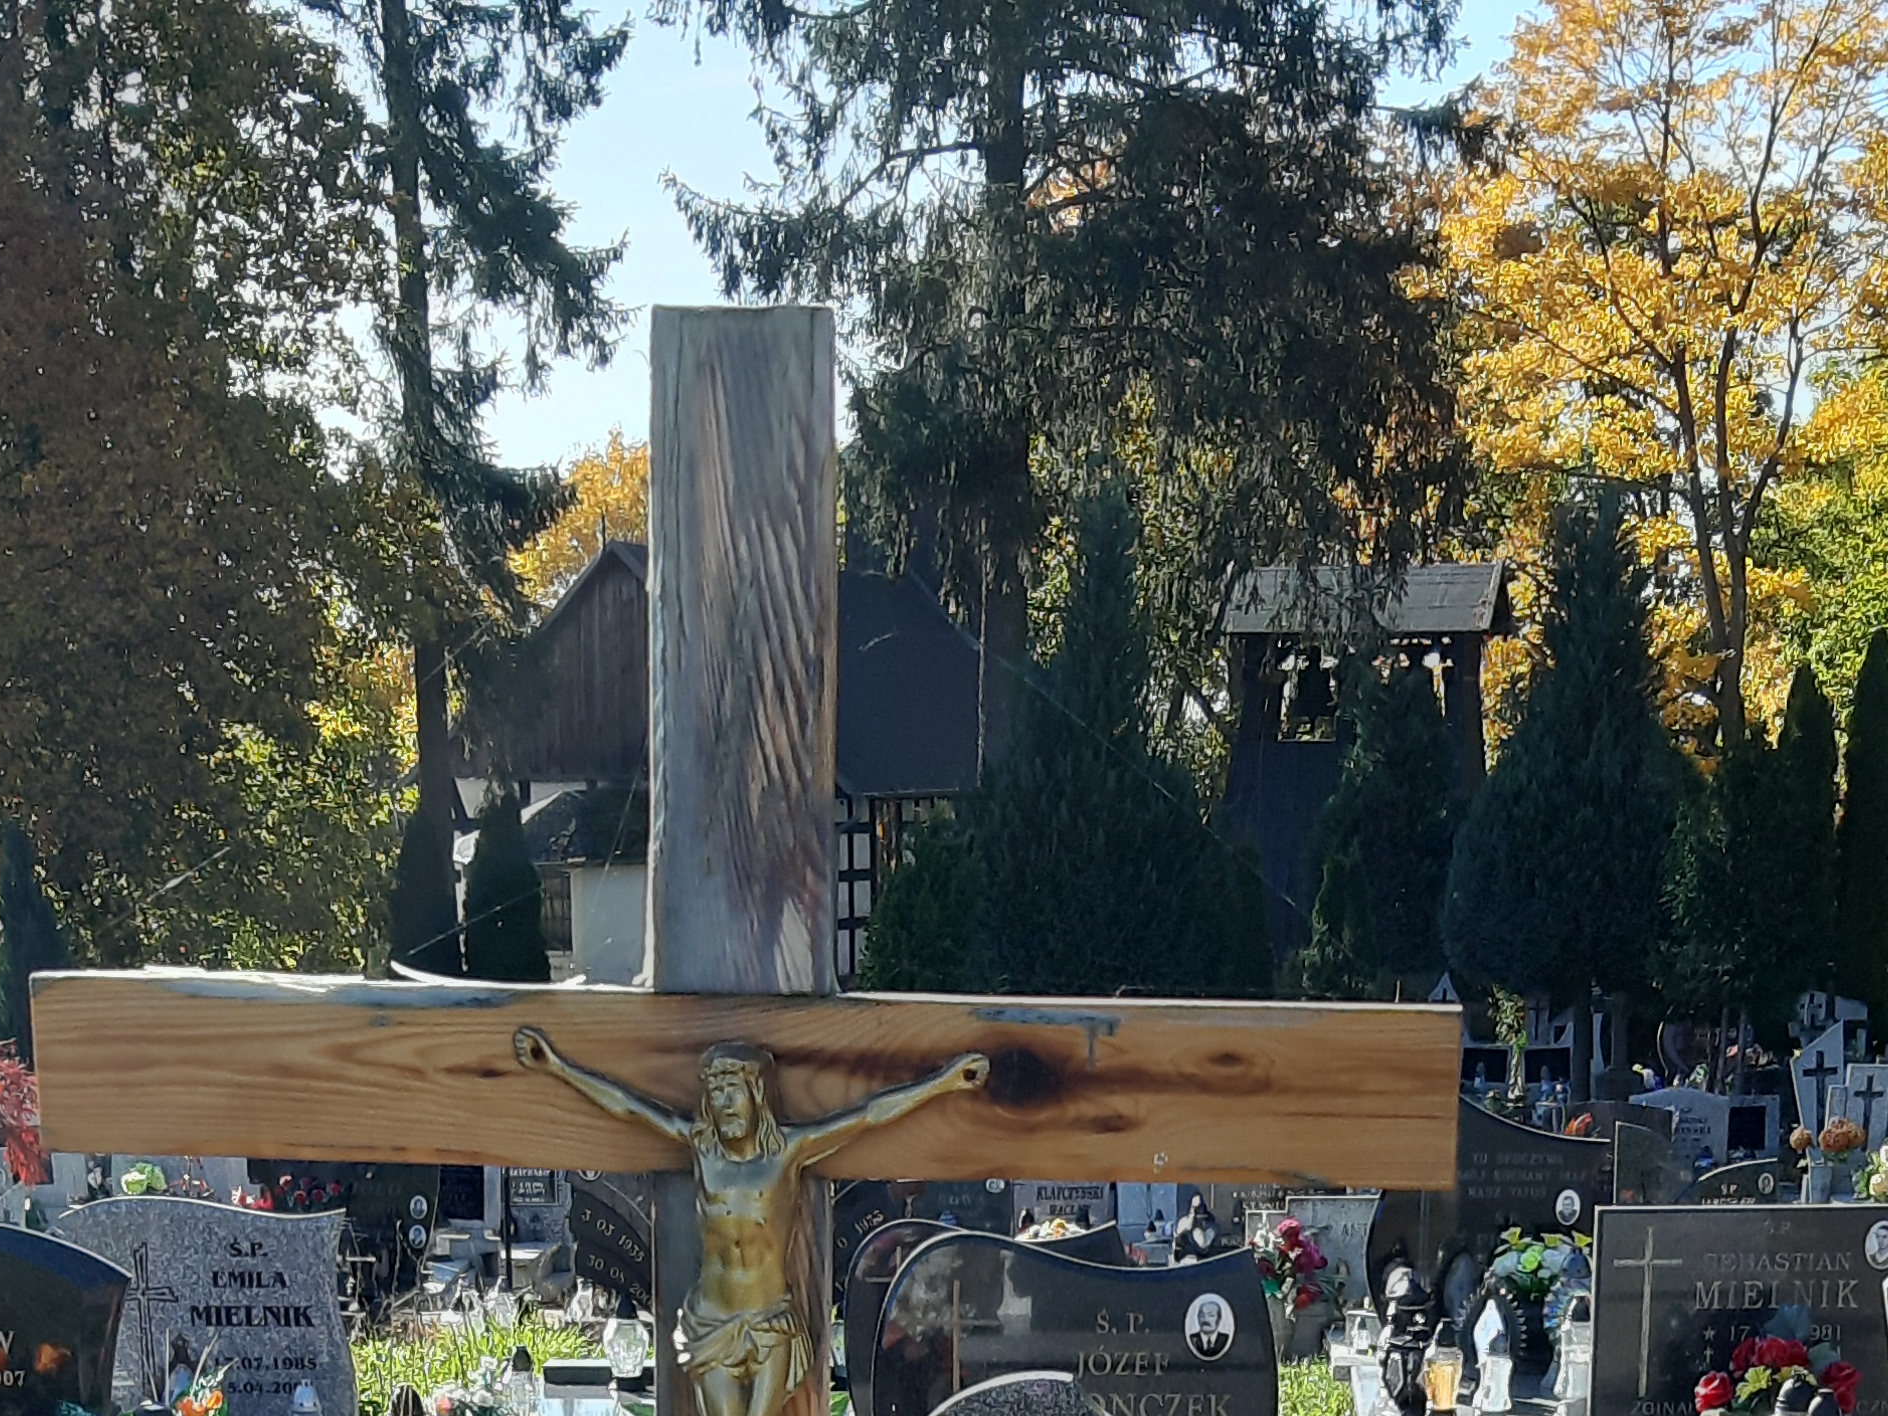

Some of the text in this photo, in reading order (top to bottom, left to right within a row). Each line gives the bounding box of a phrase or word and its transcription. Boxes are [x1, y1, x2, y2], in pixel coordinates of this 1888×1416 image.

[1704, 1252, 1852, 1273] SEBASTIAN
[1694, 1279, 1859, 1310] MIELNIK
[190, 1305, 315, 1328] MIELNIK
[1076, 1345, 1170, 1379] JÓZEF
